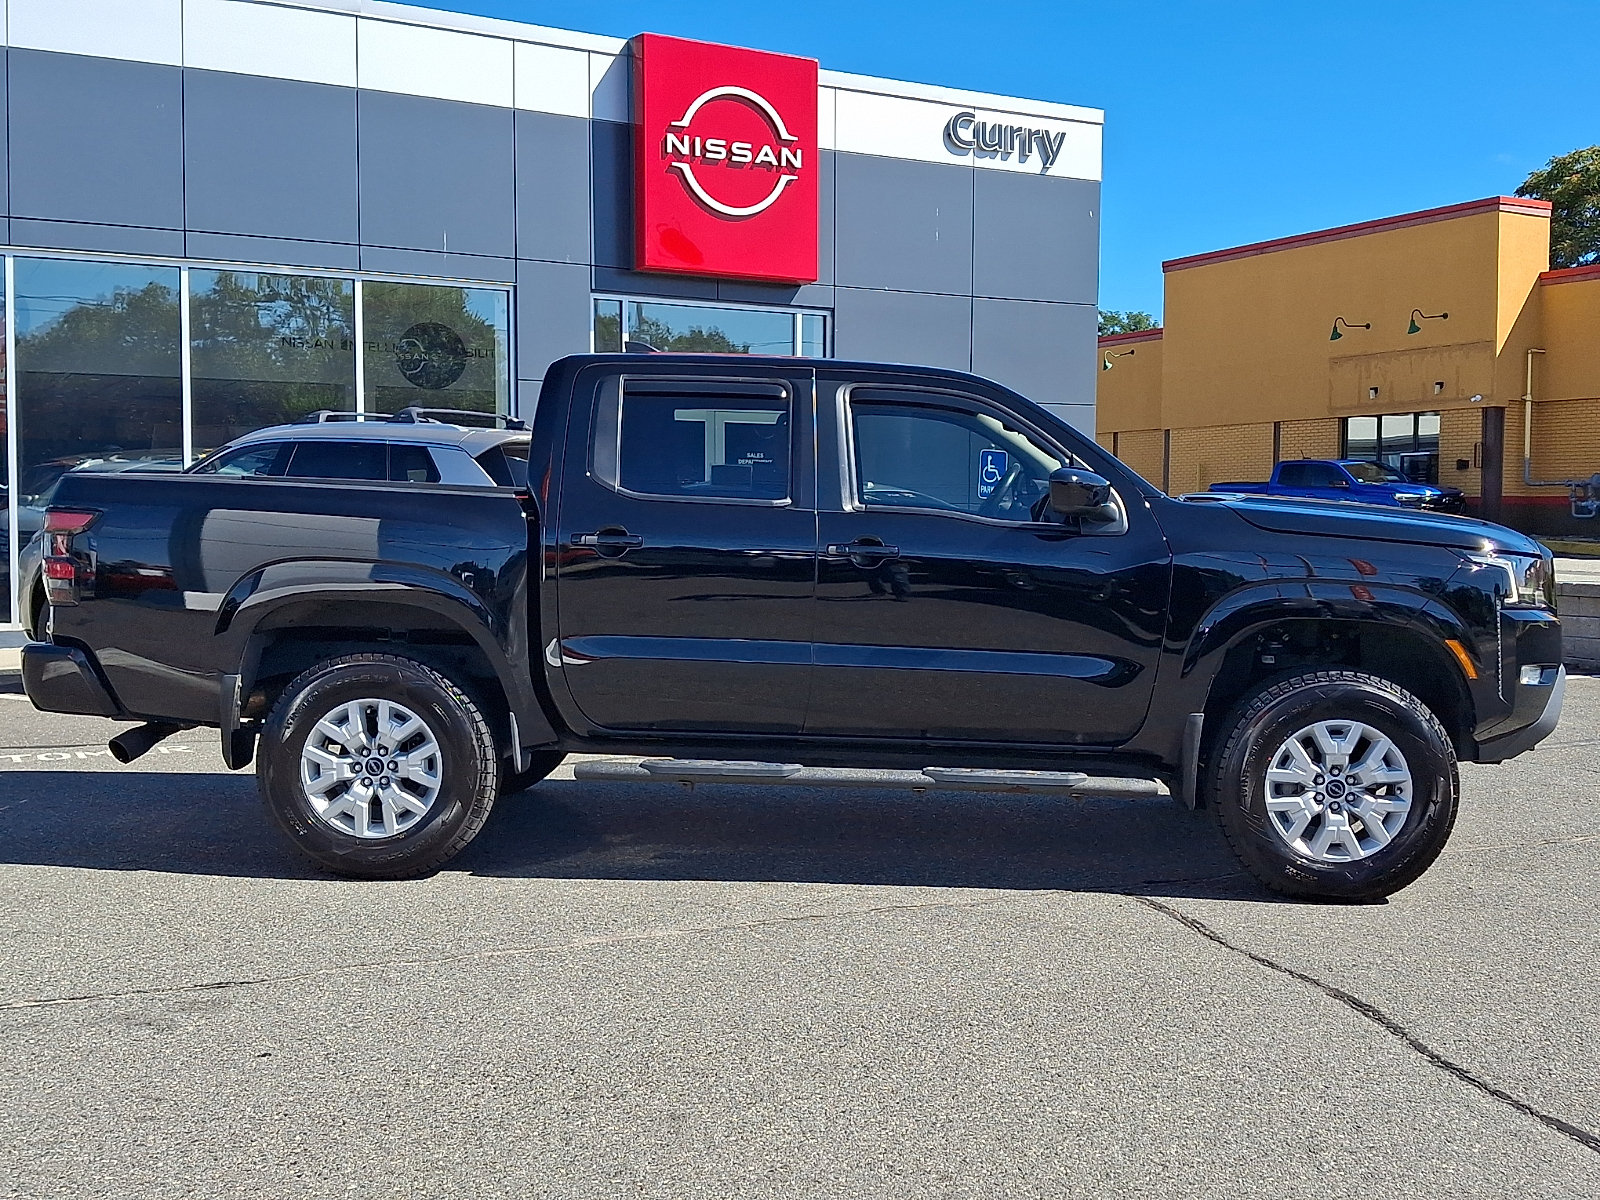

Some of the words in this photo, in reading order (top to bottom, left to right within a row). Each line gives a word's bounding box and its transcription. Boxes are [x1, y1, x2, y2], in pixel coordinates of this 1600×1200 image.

[666, 132, 802, 168] NISSAN
[950, 111, 1067, 168] Curry
[281, 337, 334, 349] NISSAN
[0, 745, 192, 763] TOMR
